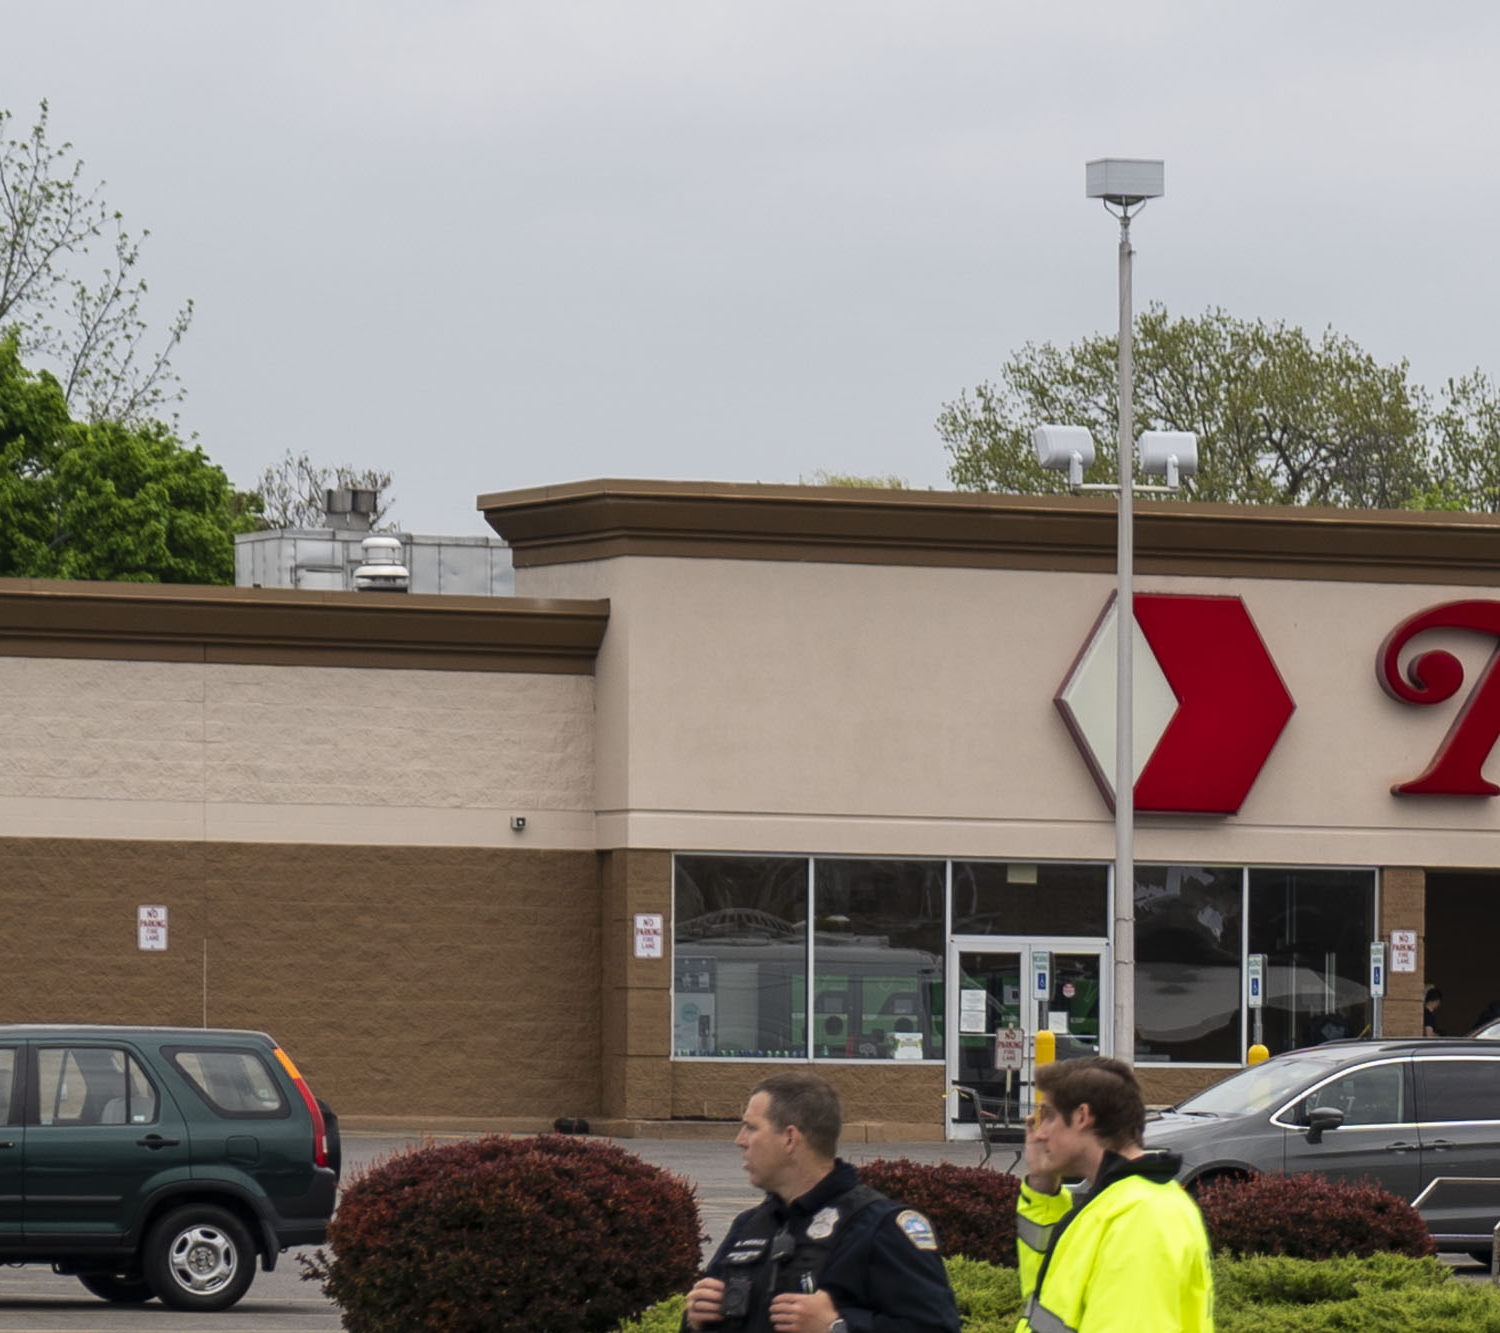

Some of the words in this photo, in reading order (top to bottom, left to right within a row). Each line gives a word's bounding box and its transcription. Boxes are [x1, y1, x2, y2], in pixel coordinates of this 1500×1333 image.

[147, 909, 158, 918] NO
[643, 919, 654, 927] NO
[1398, 935, 1409, 943] NO
[1005, 1031, 1016, 1040] NO
